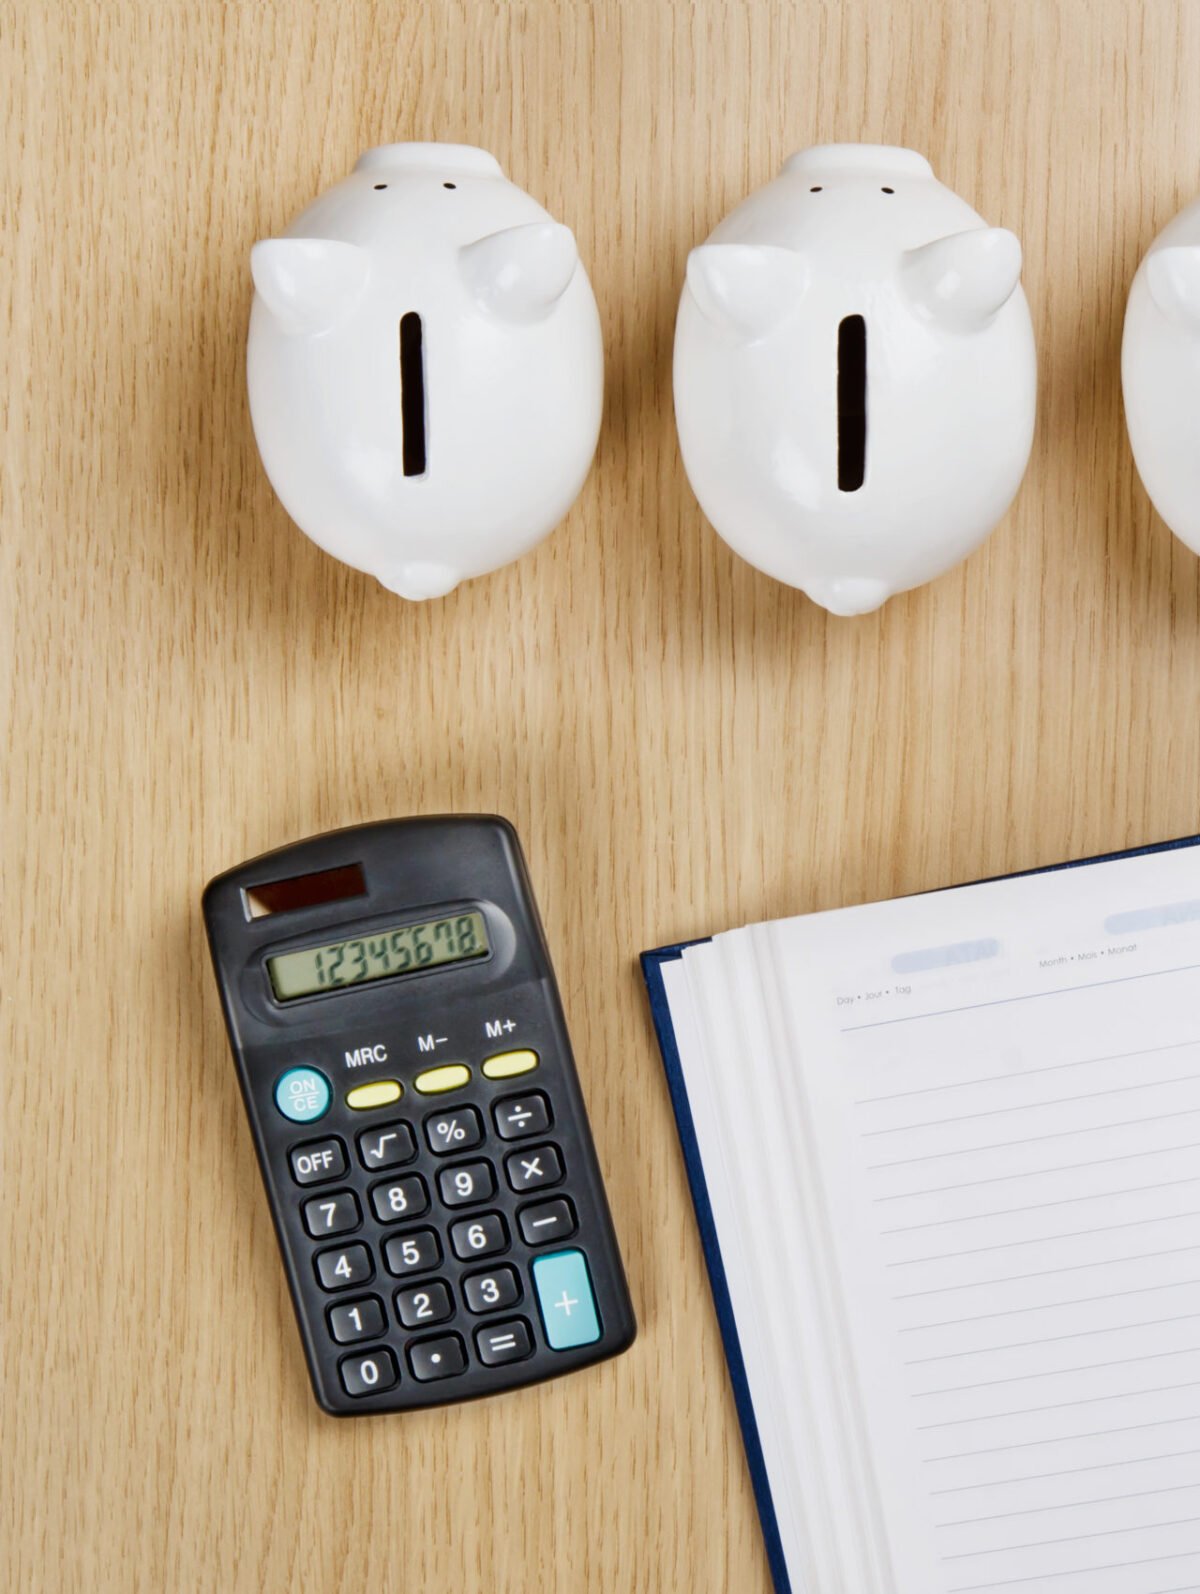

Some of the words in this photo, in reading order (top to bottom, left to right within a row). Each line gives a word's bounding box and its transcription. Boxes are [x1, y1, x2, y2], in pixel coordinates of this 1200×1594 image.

[1039, 955, 1068, 969] Month
[1077, 951, 1098, 961] Mois
[1107, 943, 1137, 956] Monat
[836, 996, 854, 1006] Day
[894, 985, 912, 996] Tag
[485, 1018, 517, 1039] M+
[345, 1044, 388, 1069] MRC
[290, 1077, 316, 1096] ON
[293, 1096, 319, 1112] CE
[436, 1119, 466, 1143] %
[296, 1150, 334, 1175] OFF
[454, 1171, 474, 1197] 9
[387, 1187, 408, 1212] 8
[319, 1202, 337, 1228] 7
[467, 1223, 487, 1250] 6
[401, 1240, 421, 1265] 5
[333, 1254, 353, 1280] 4
[481, 1277, 500, 1303] 3
[413, 1292, 434, 1319] 2
[554, 1290, 579, 1316] +
[348, 1307, 363, 1332] 1
[360, 1359, 379, 1385] 0
